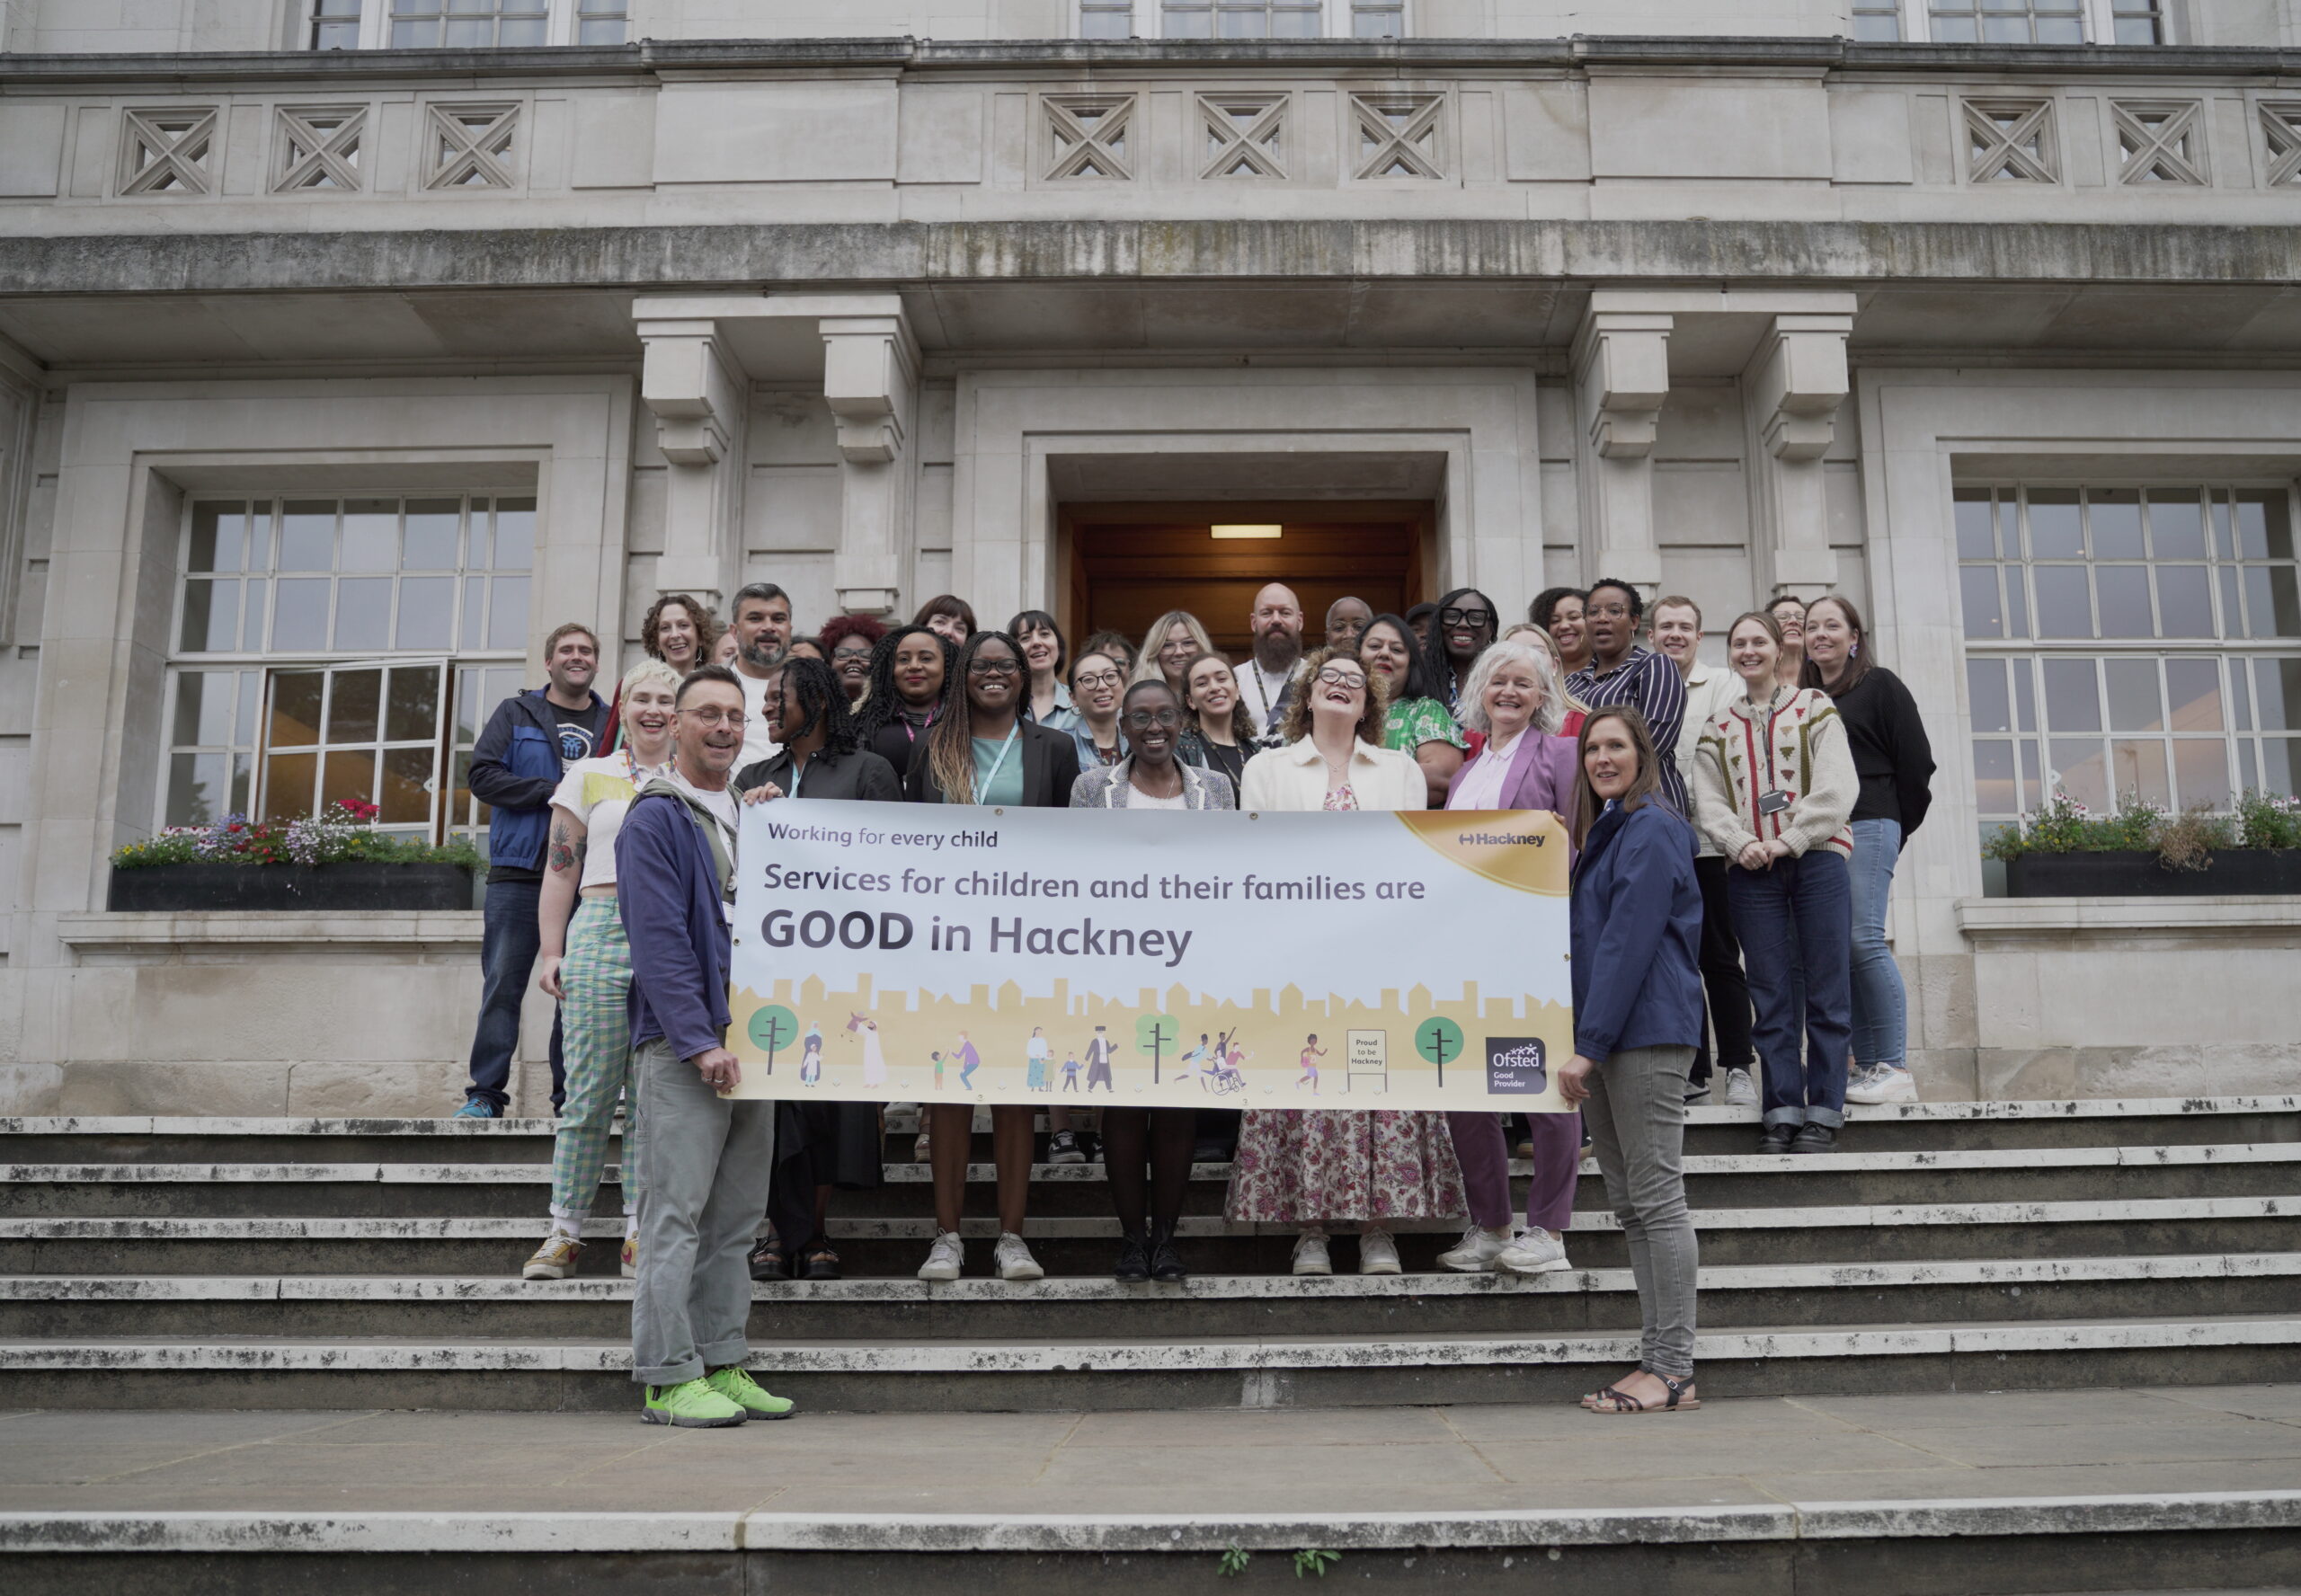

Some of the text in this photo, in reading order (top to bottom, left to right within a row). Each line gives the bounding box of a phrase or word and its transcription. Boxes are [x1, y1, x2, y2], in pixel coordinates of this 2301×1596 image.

[768, 822, 998, 851] Working for every child
[1476, 833, 1546, 847] Hackney
[763, 863, 1426, 900] Services for children and their families are
[760, 909, 1194, 968] GOOD in Hackney
[1351, 1058, 1383, 1067] Hackney
[1493, 1052, 1540, 1068] Ofsted
[1493, 1071, 1515, 1079] Good
[1494, 1079, 1526, 1087] Provider
